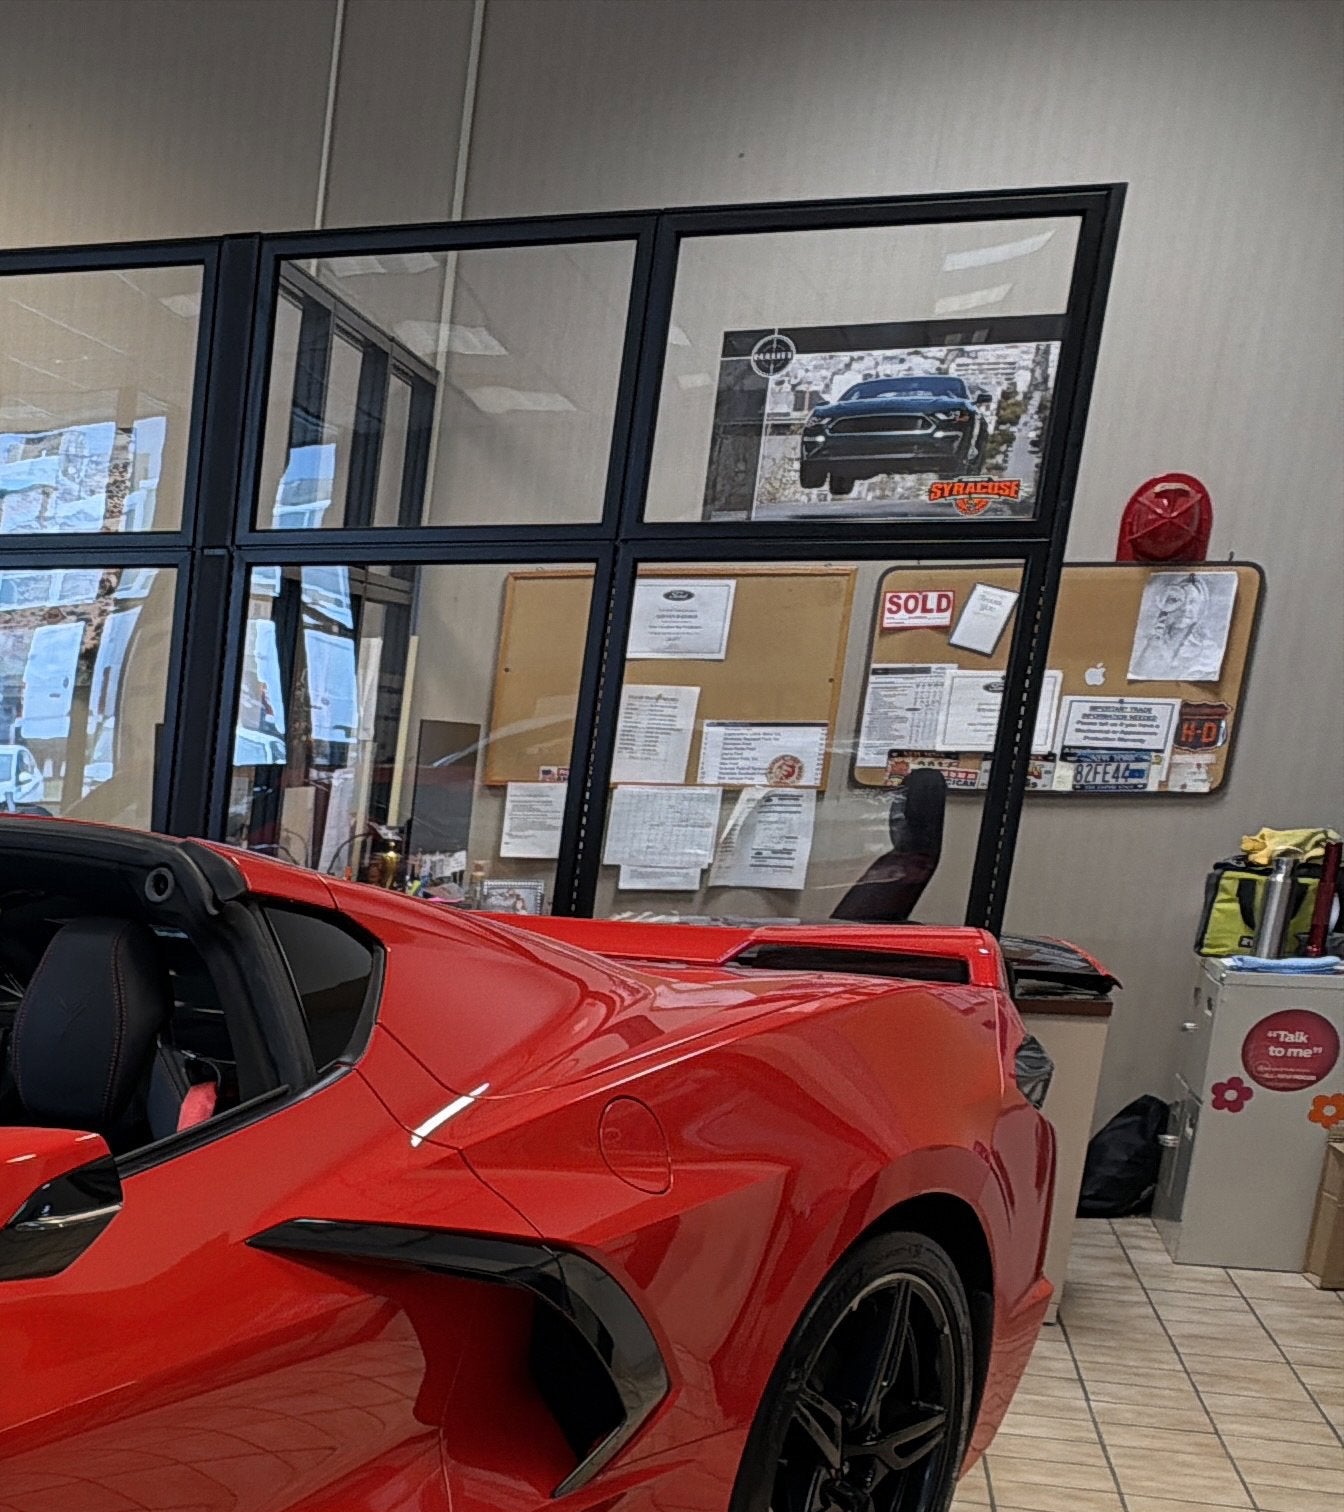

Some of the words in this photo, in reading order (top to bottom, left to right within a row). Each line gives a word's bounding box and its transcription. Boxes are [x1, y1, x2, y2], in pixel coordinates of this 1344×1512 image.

[930, 480, 1019, 500] SYRACUSE
[886, 593, 951, 615] SOLD
[1266, 1030, 1309, 1043] “Talk
[1268, 1045, 1285, 1057] to
[1286, 1046, 1323, 1058] me”
